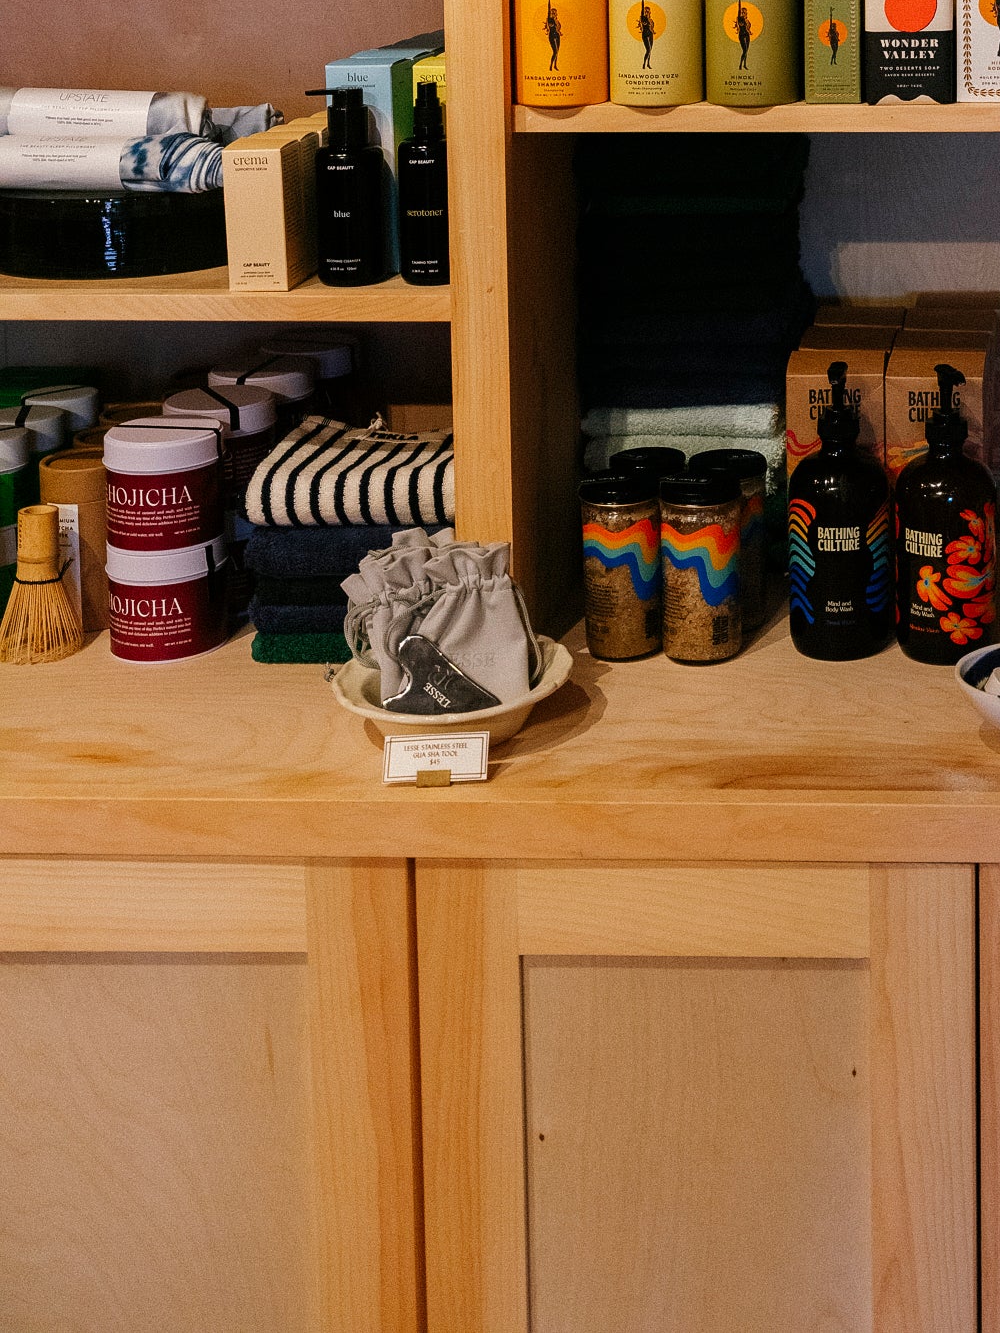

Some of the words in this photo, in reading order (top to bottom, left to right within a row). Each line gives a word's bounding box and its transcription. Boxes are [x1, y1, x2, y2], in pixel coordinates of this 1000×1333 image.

[880, 39, 940, 48] WONDER
[882, 50, 937, 59] VALLEY
[347, 72, 369, 82] blue
[60, 92, 111, 103] UPSTATE
[233, 156, 269, 166] crema
[333, 210, 351, 218] blue
[407, 209, 443, 217] serotoner
[108, 483, 193, 507] HOJICHA
[817, 526, 860, 540] BATHING
[905, 527, 943, 546] BATHING
[817, 538, 860, 552] CULTURE
[905, 540, 943, 558] CULTURE
[910, 608, 921, 616] Body
[921, 610, 935, 618] Wash
[423, 682, 452, 709] LESSE
[404, 744, 420, 752] LESSE
[421, 743, 451, 751] STAINLESS
[451, 742, 468, 750] STEEL
